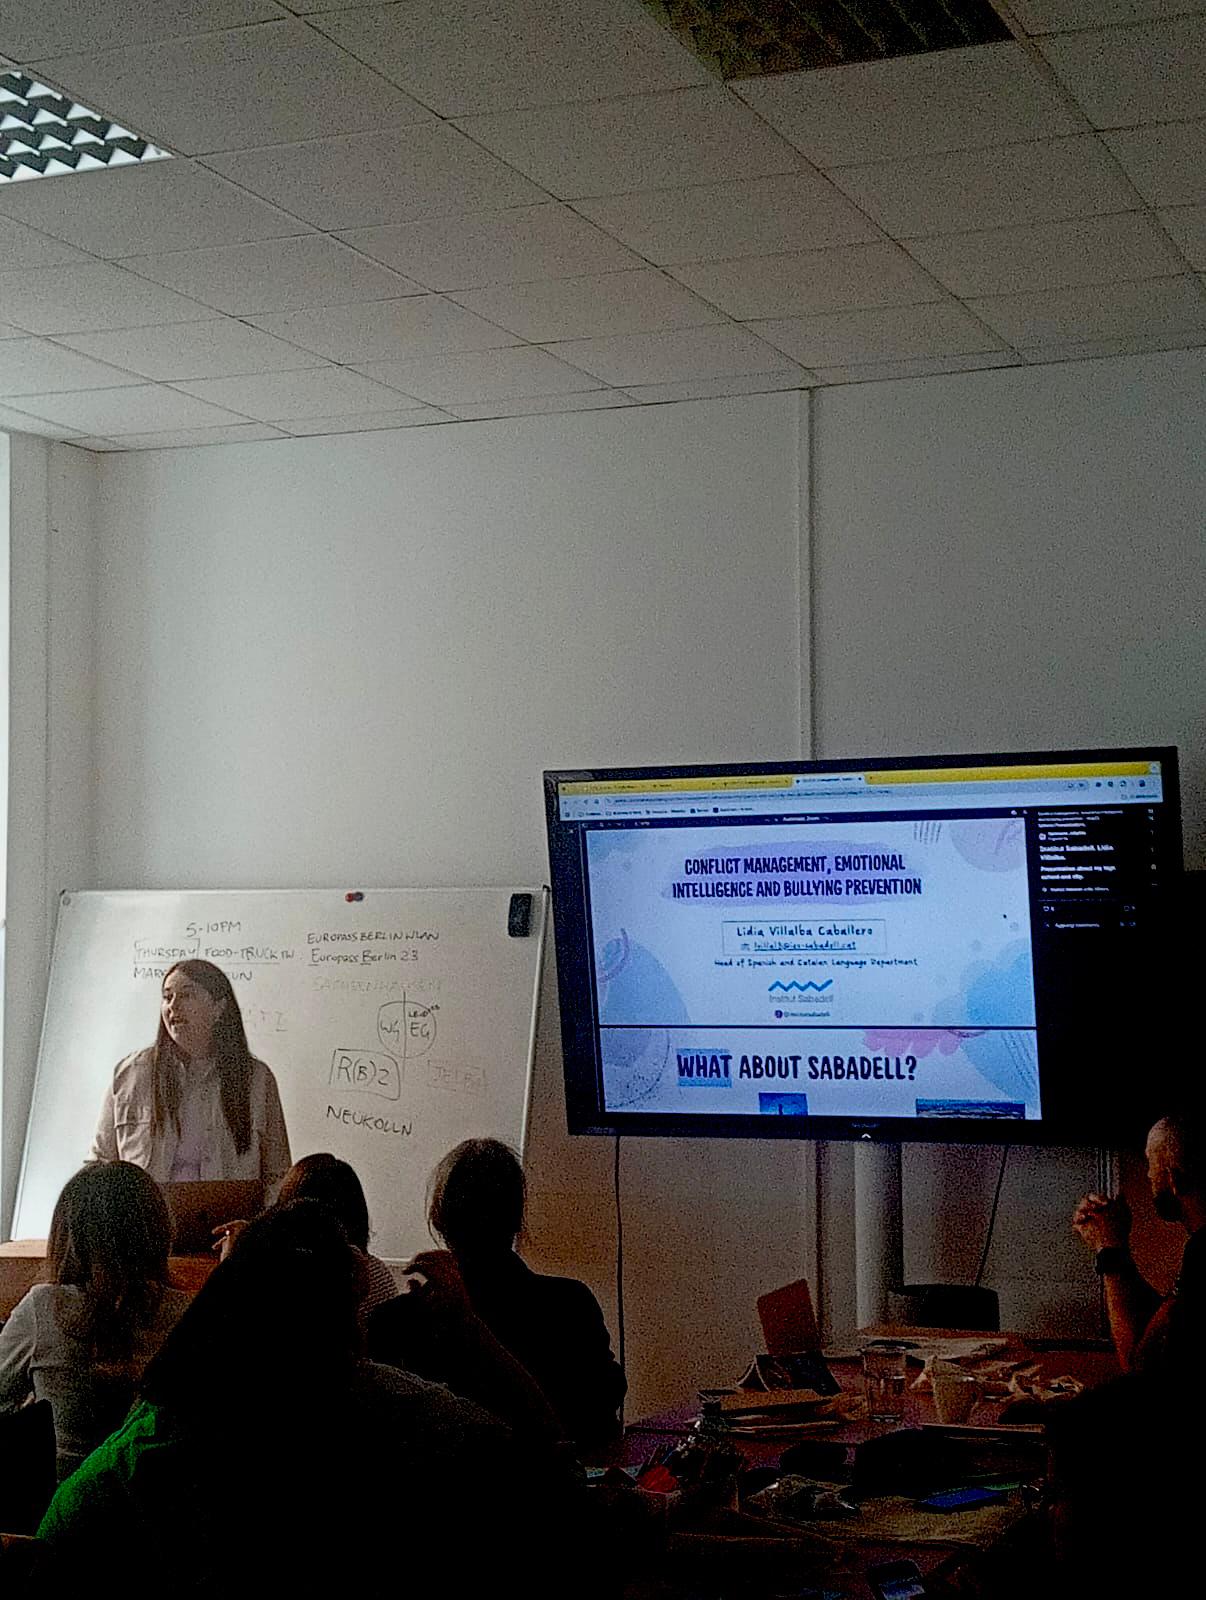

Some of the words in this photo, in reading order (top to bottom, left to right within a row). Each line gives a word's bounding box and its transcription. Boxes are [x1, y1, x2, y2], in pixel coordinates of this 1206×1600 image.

[684, 857, 740, 875] CONFLICT
[743, 855, 832, 875] MANAGEMENT,
[835, 854, 906, 872] EMOTIONAL
[672, 881, 753, 899] INTELLIGENCE
[756, 880, 781, 897] AND
[784, 879, 843, 897] BULLYING
[845, 878, 922, 896] PREVENTION
[736, 926, 765, 937] Lidia
[769, 924, 813, 937] Villalba
[818, 924, 873, 937] Caballero
[677, 1055, 733, 1078] WHAT
[739, 1055, 802, 1079] ABOUT
[808, 1055, 918, 1081] SABADELL?
